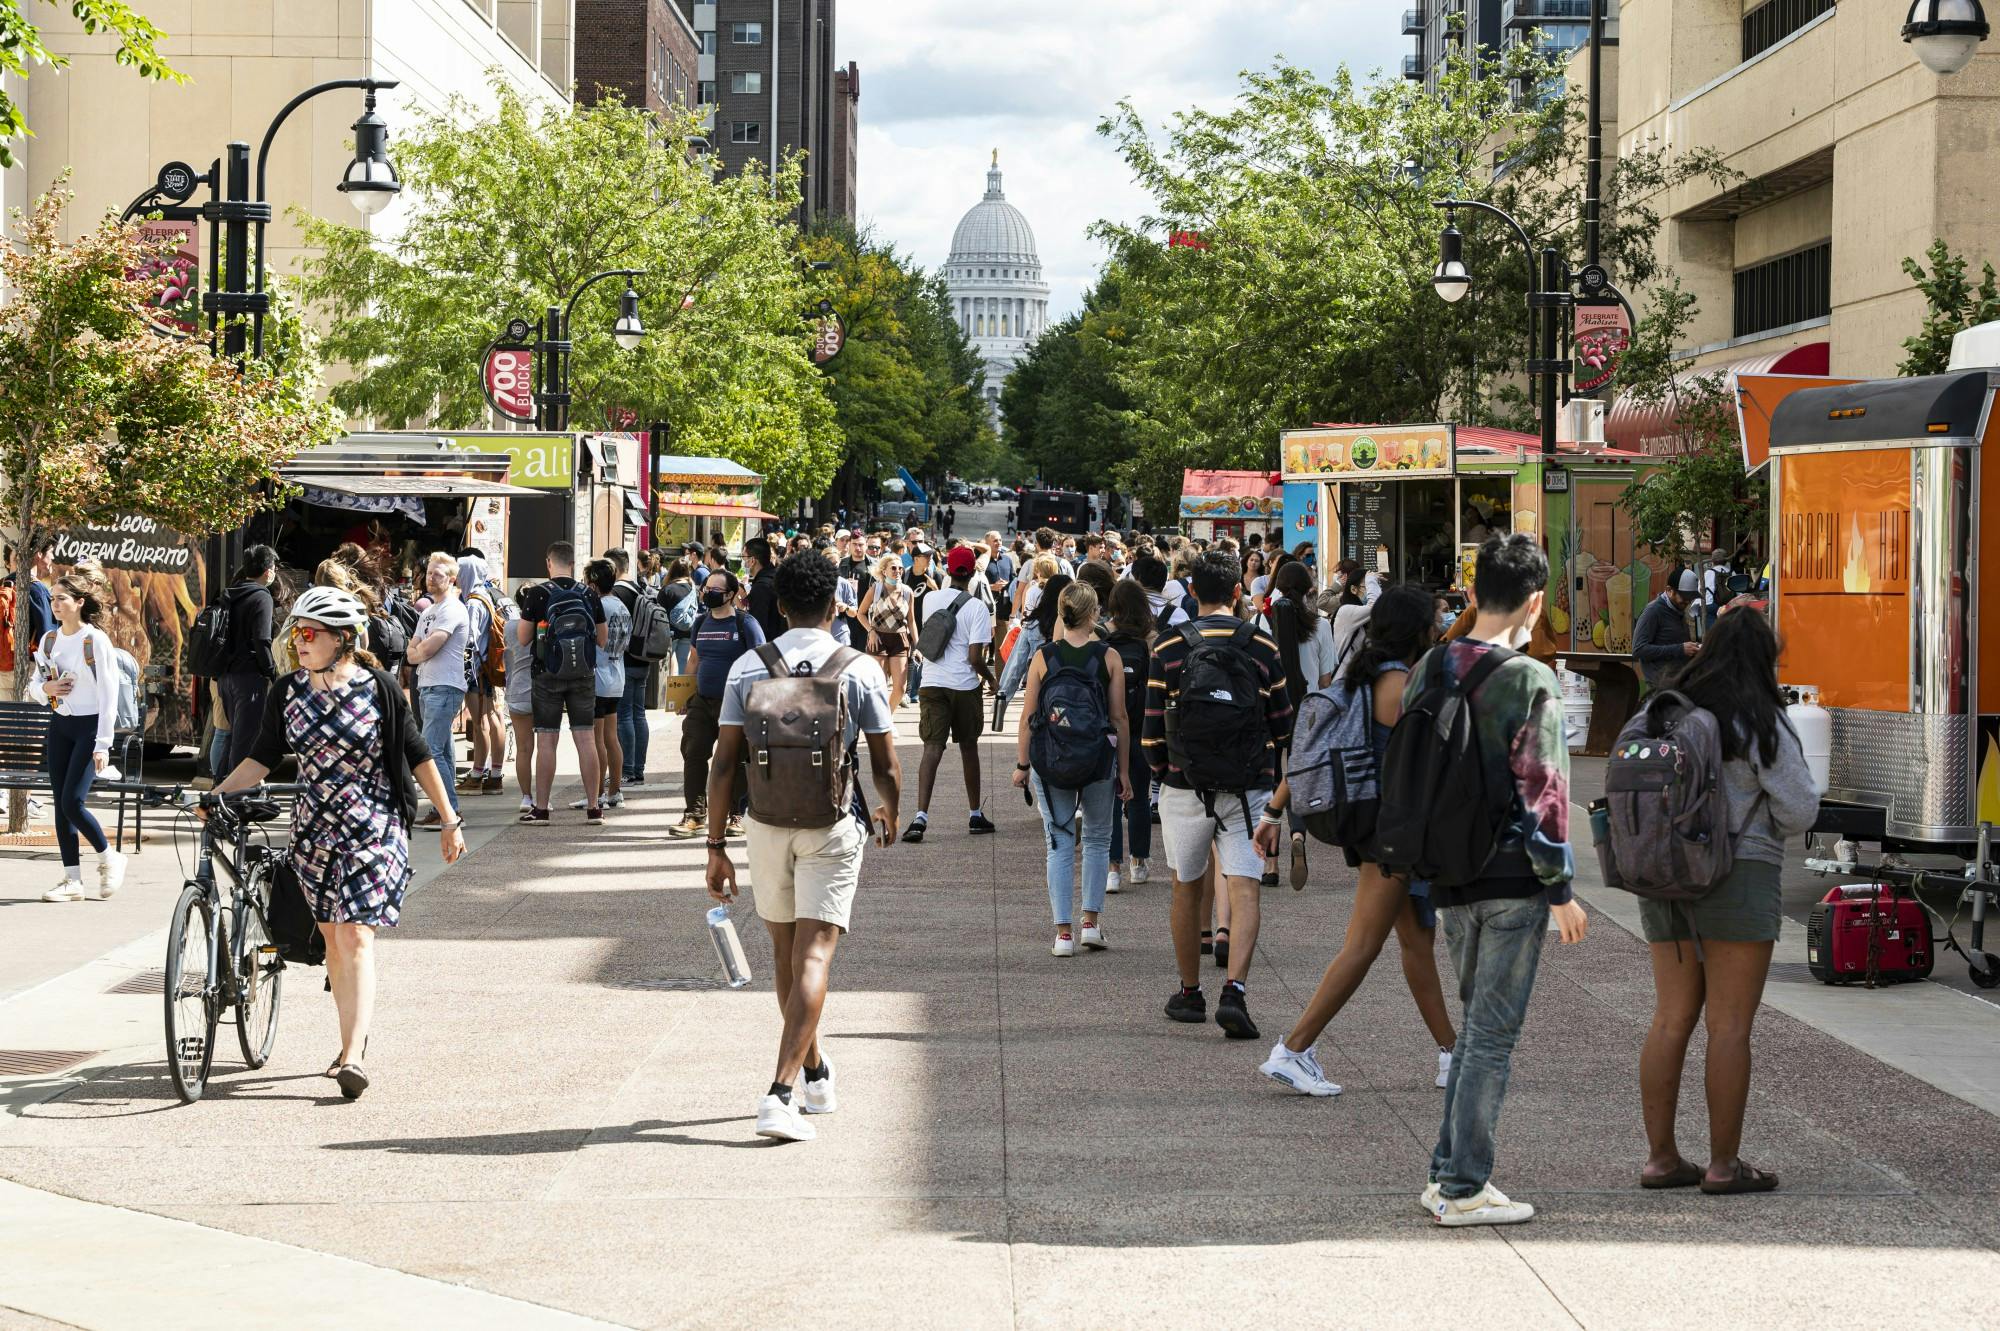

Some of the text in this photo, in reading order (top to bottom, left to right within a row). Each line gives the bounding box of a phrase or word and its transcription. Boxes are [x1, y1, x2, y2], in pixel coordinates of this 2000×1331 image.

[1580, 318, 1618, 327] Madison
[494, 352, 517, 406] 700
[517, 363, 530, 406] BLOCK
[55, 534, 189, 566] KOREAN BURRITO
[1781, 512, 1839, 580] HIBACHI
[1880, 511, 1910, 580] HUT
